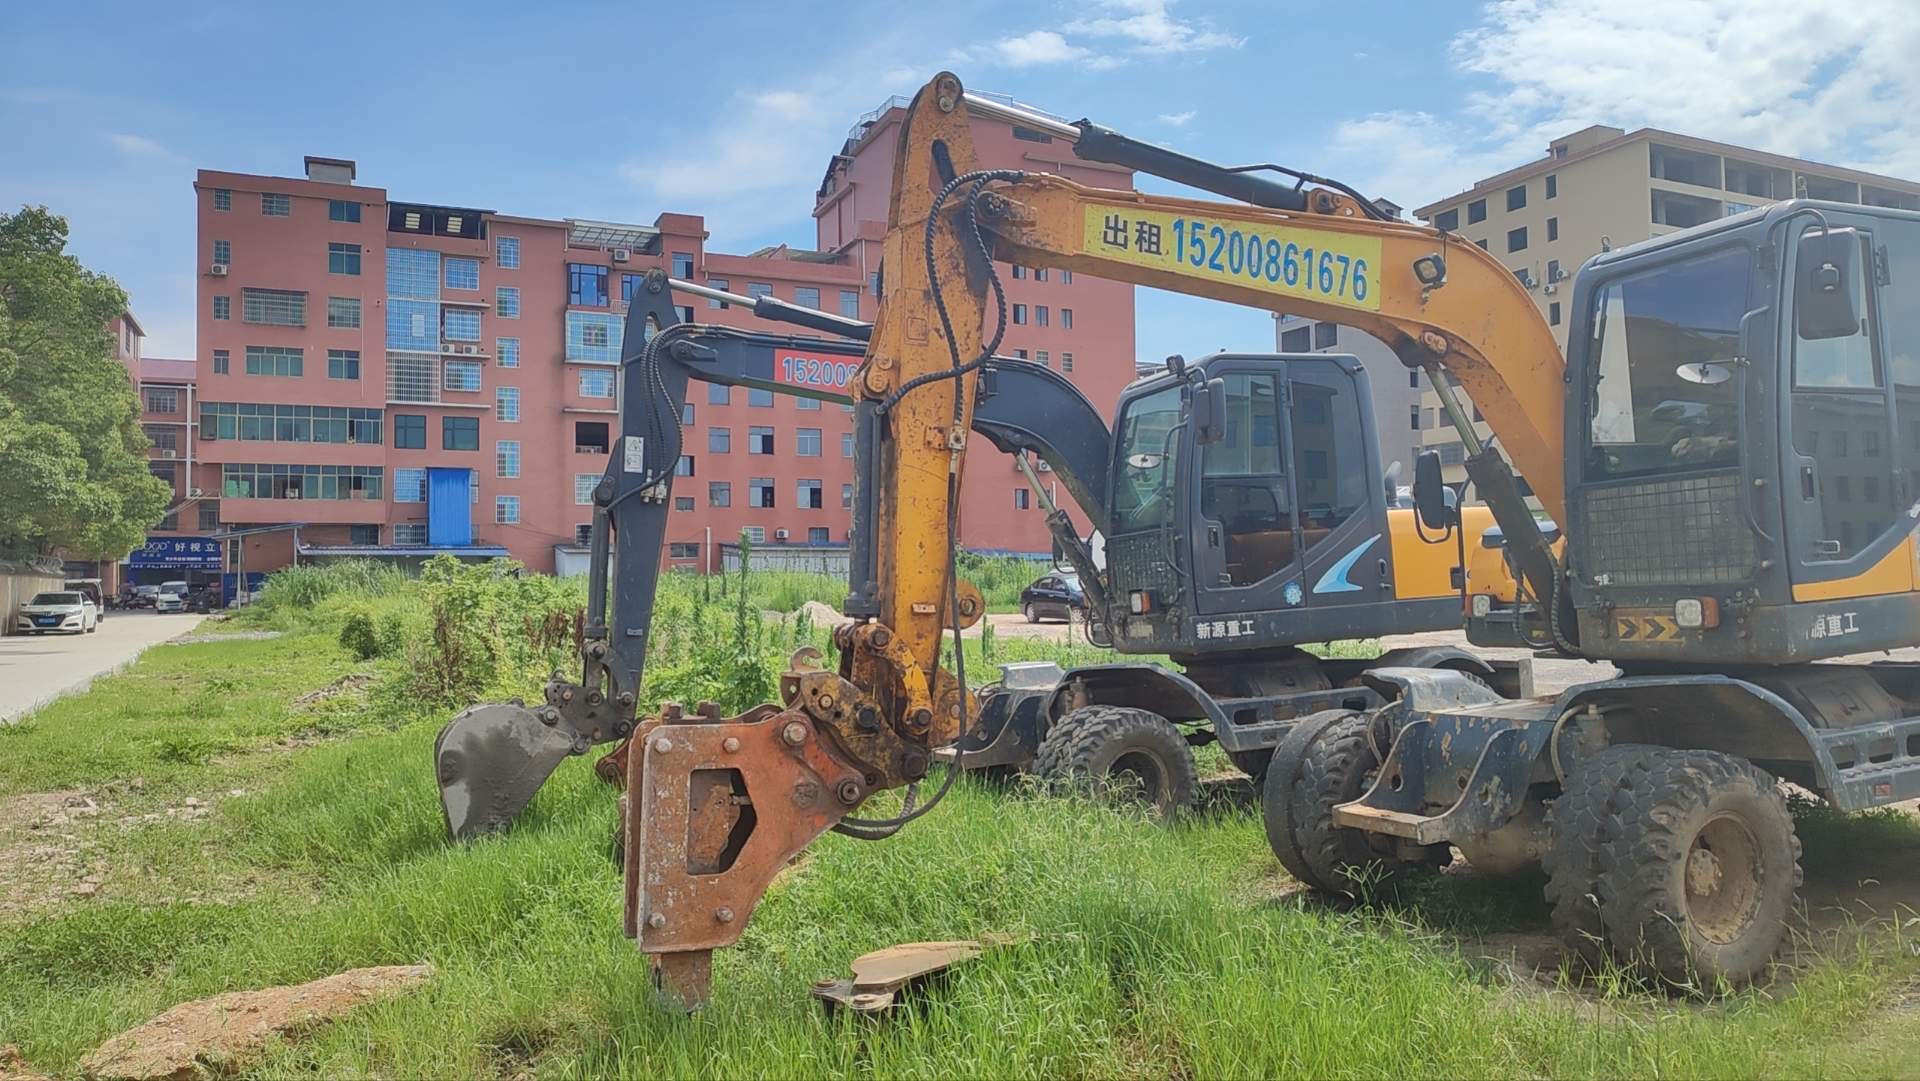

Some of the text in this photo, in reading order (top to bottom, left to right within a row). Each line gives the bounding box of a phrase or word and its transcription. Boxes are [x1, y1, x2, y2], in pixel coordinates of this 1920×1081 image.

[1103, 214, 1368, 301] 出租 15200861676
[1196, 620, 1256, 640] 新源重工
